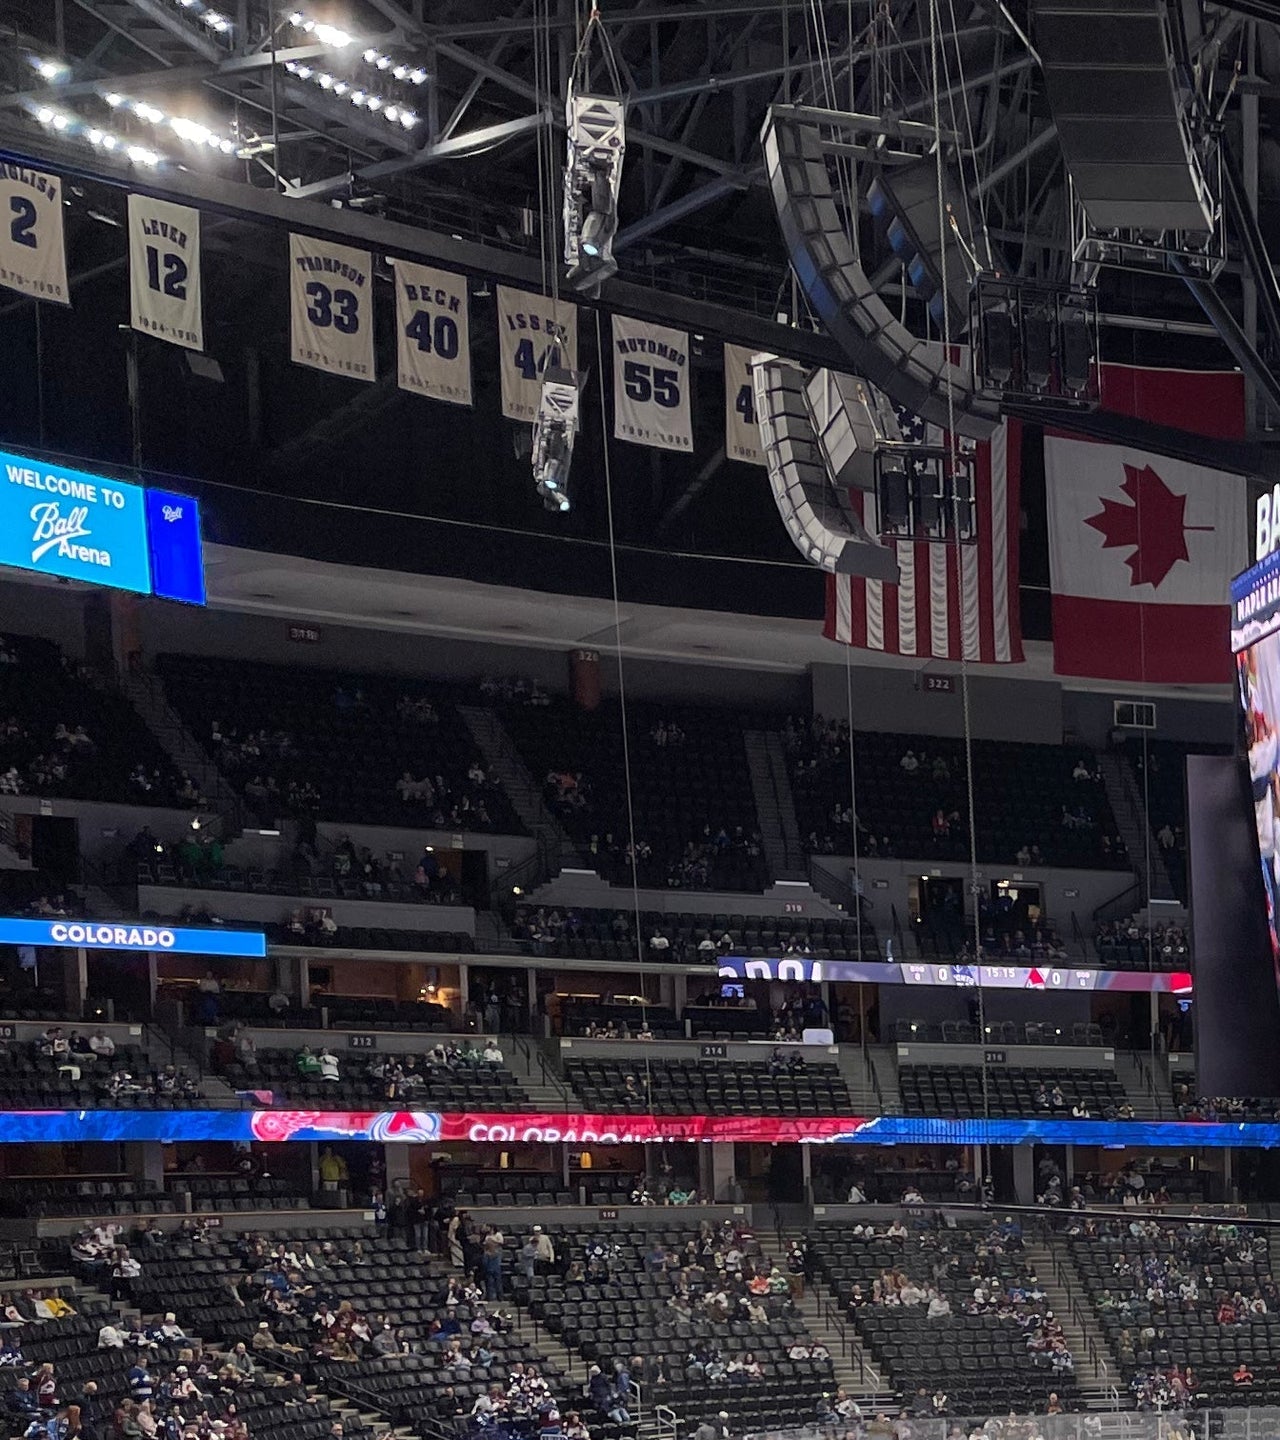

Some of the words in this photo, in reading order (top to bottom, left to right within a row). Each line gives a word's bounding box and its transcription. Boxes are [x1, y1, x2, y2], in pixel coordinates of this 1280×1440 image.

[9, 195, 38, 250] 2
[141, 217, 188, 250] LEVER
[145, 244, 189, 301] 12
[296, 255, 366, 288] THOMPSON
[305, 281, 360, 336] 33
[403, 282, 460, 315] BECK
[404, 309, 459, 361] 40
[616, 337, 687, 367] MUTOMBO
[623, 360, 682, 410] 55
[6, 464, 98, 503] WELCOME
[101, 487, 125, 510] TO
[30, 501, 93, 544] Ball
[57, 536, 111, 567] Arena
[928, 678, 950, 690] 322
[786, 903, 802, 913] 319
[51, 924, 175, 948] COLORADO
[938, 968, 947, 982] 0
[986, 967, 1015, 978] 15:15
[1052, 971, 1060, 985] 0
[352, 1036, 372, 1047] 212
[704, 1046, 722, 1056] 214
